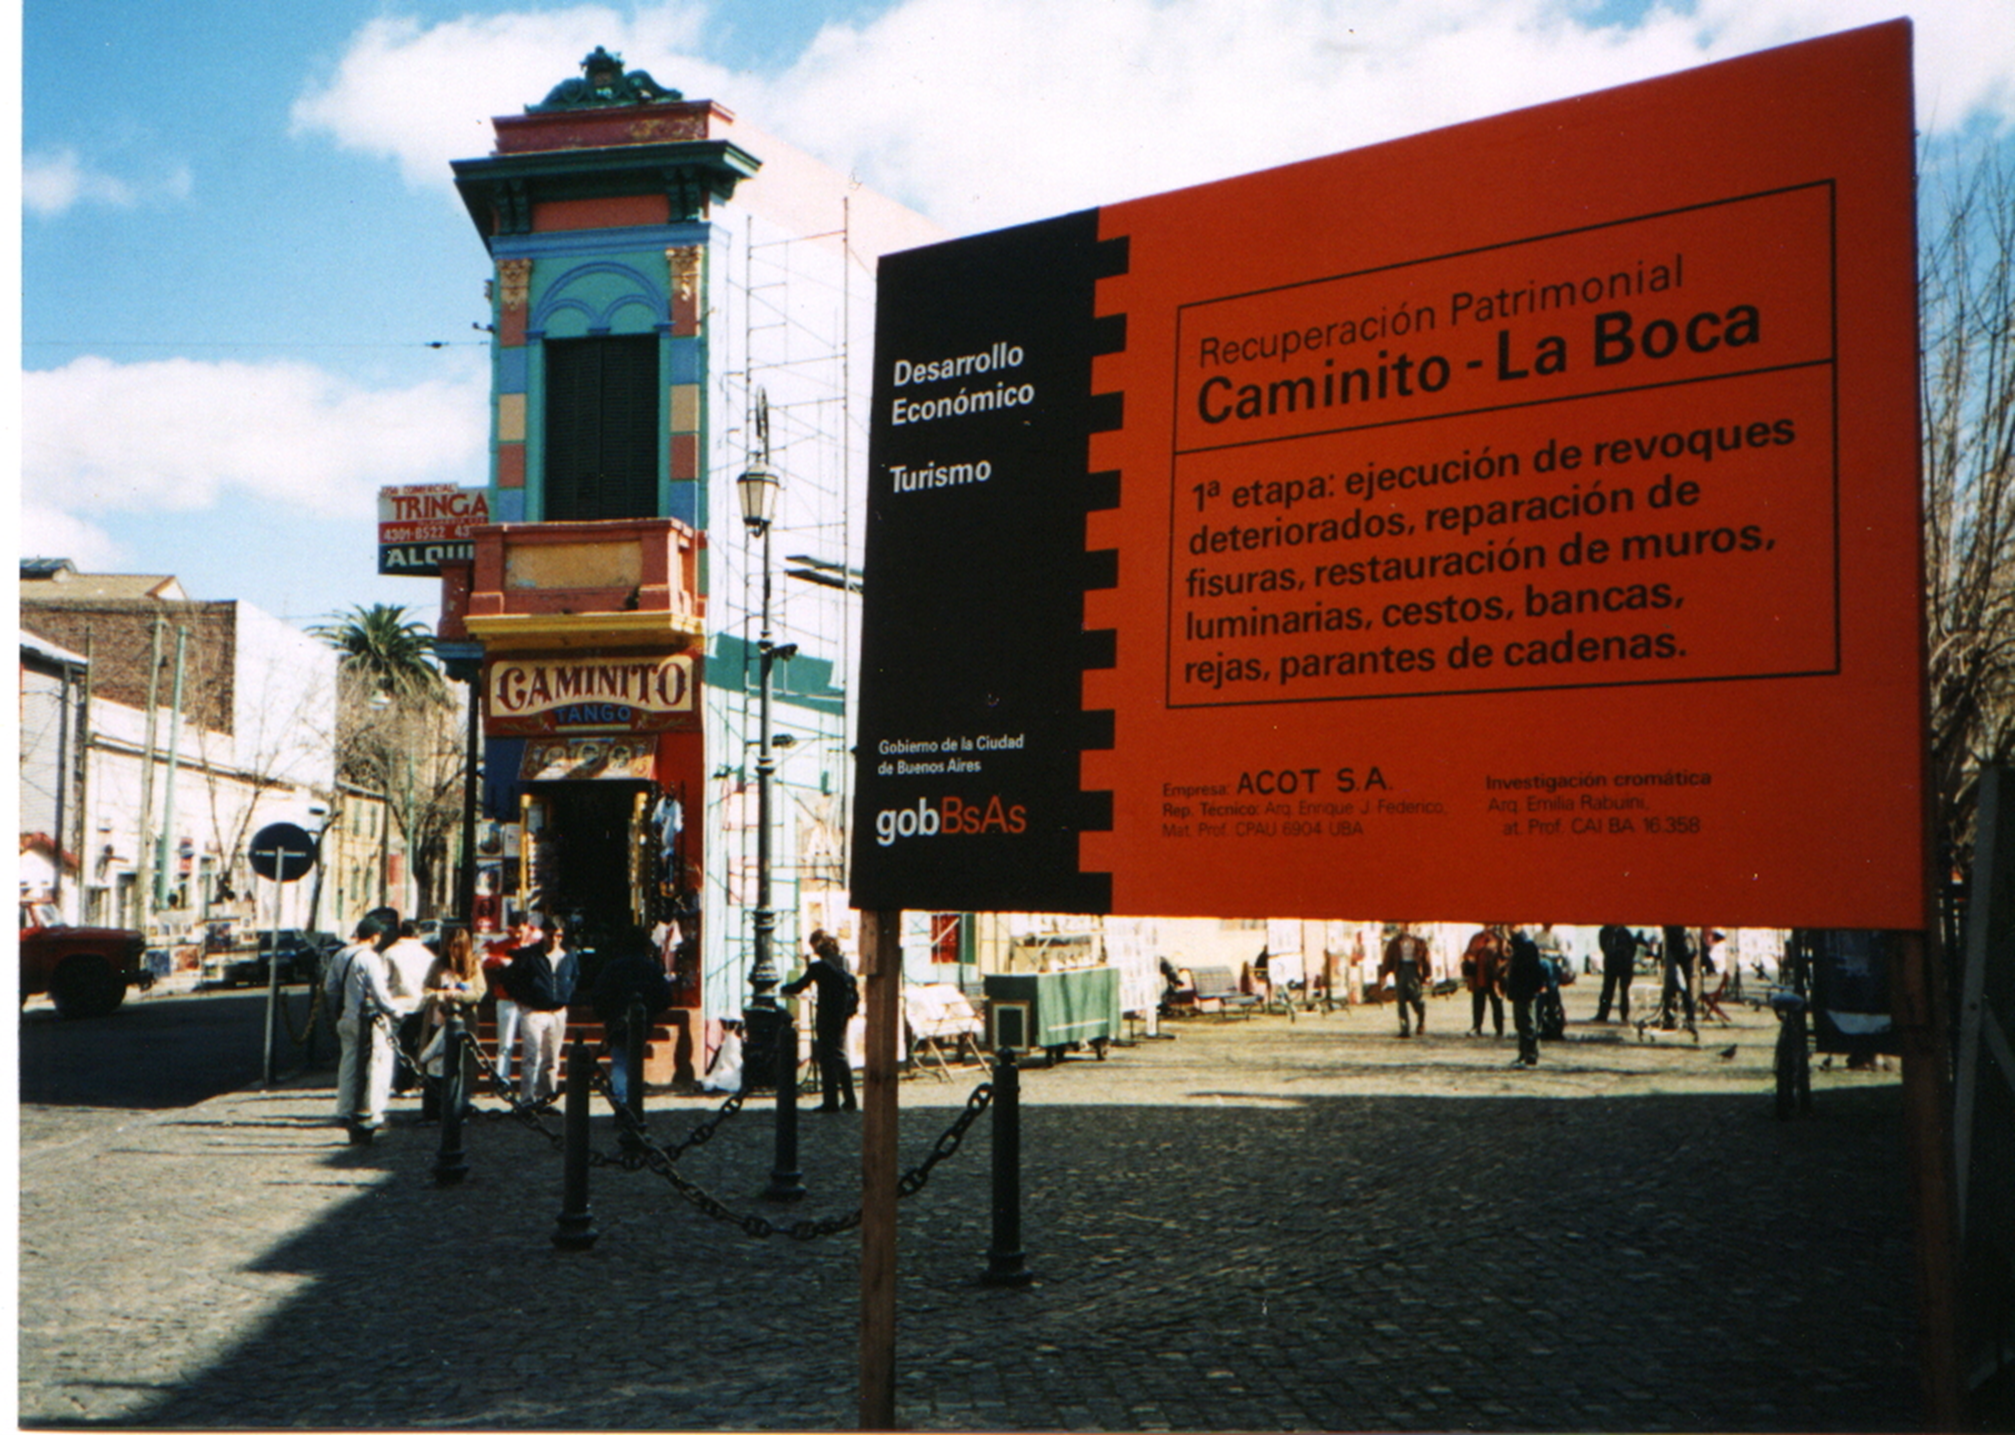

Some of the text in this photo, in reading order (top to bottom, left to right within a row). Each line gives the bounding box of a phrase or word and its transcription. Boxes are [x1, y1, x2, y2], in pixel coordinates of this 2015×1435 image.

[1200, 252, 1683, 367] Recuperación Patrimonial
[893, 341, 1024, 387] Desarrollo
[1198, 350, 1451, 425] Caminito
[1497, 329, 1568, 382] La
[1594, 304, 1760, 367] Boca
[892, 381, 1036, 426] Económico
[889, 460, 992, 493] Turismo
[1231, 473, 1335, 509] etapa:
[1345, 447, 1520, 501] ejecución
[1533, 439, 1582, 473] de
[1594, 417, 1796, 466] revoques
[391, 491, 489, 520] TRINGA
[1189, 473, 1700, 555] deteriorados, reparación de
[1186, 524, 1775, 598] fisuras, restauración de muros,
[1186, 582, 1684, 641] luminarias, cestos, bancas,
[1185, 629, 1687, 690] rejas, parantes de cadenas.
[497, 662, 687, 711] CAMINITO
[554, 706, 631, 723] TANGO
[877, 757, 981, 775] de Buenos Aires
[878, 733, 1024, 755] Gobierno de la Ciudad
[1162, 781, 1230, 801] Empresa:
[1236, 768, 1321, 796] ACOT
[1485, 769, 1713, 793] Investigación cromática
[1526, 793, 1575, 812] Emilia
[876, 794, 1027, 847] gobBsAs
[1236, 819, 1278, 837] CPAU
[1282, 819, 1323, 836] 6904
[1328, 818, 1364, 836] UBA
[1608, 815, 1636, 834] BA
[1642, 814, 1701, 834] 16.358
